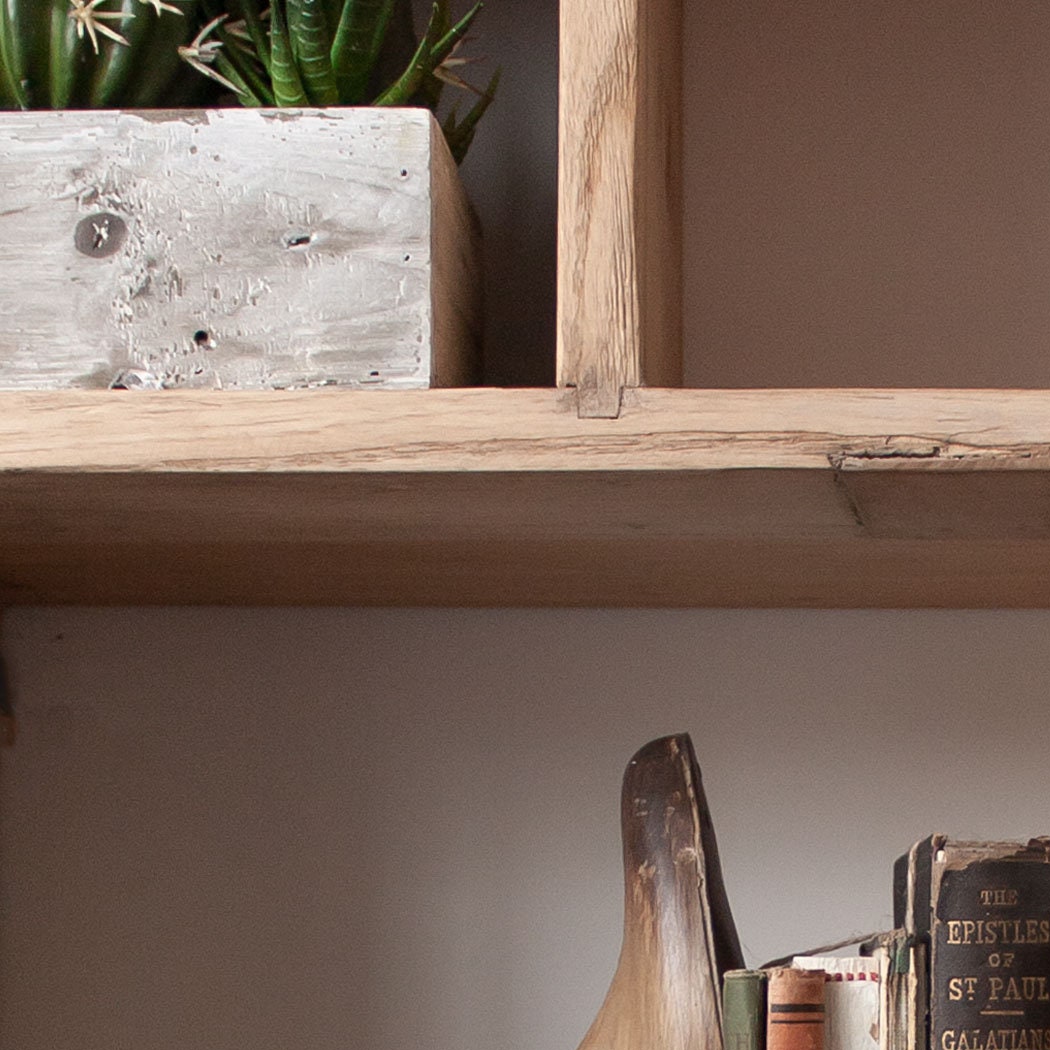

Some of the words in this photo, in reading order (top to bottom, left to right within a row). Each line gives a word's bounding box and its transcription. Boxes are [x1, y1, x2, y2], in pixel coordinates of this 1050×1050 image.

[980, 889, 1018, 906] THE
[946, 919, 1050, 945] EPISTLES
[988, 953, 1015, 968] OF
[989, 976, 1050, 1001] PAUL
